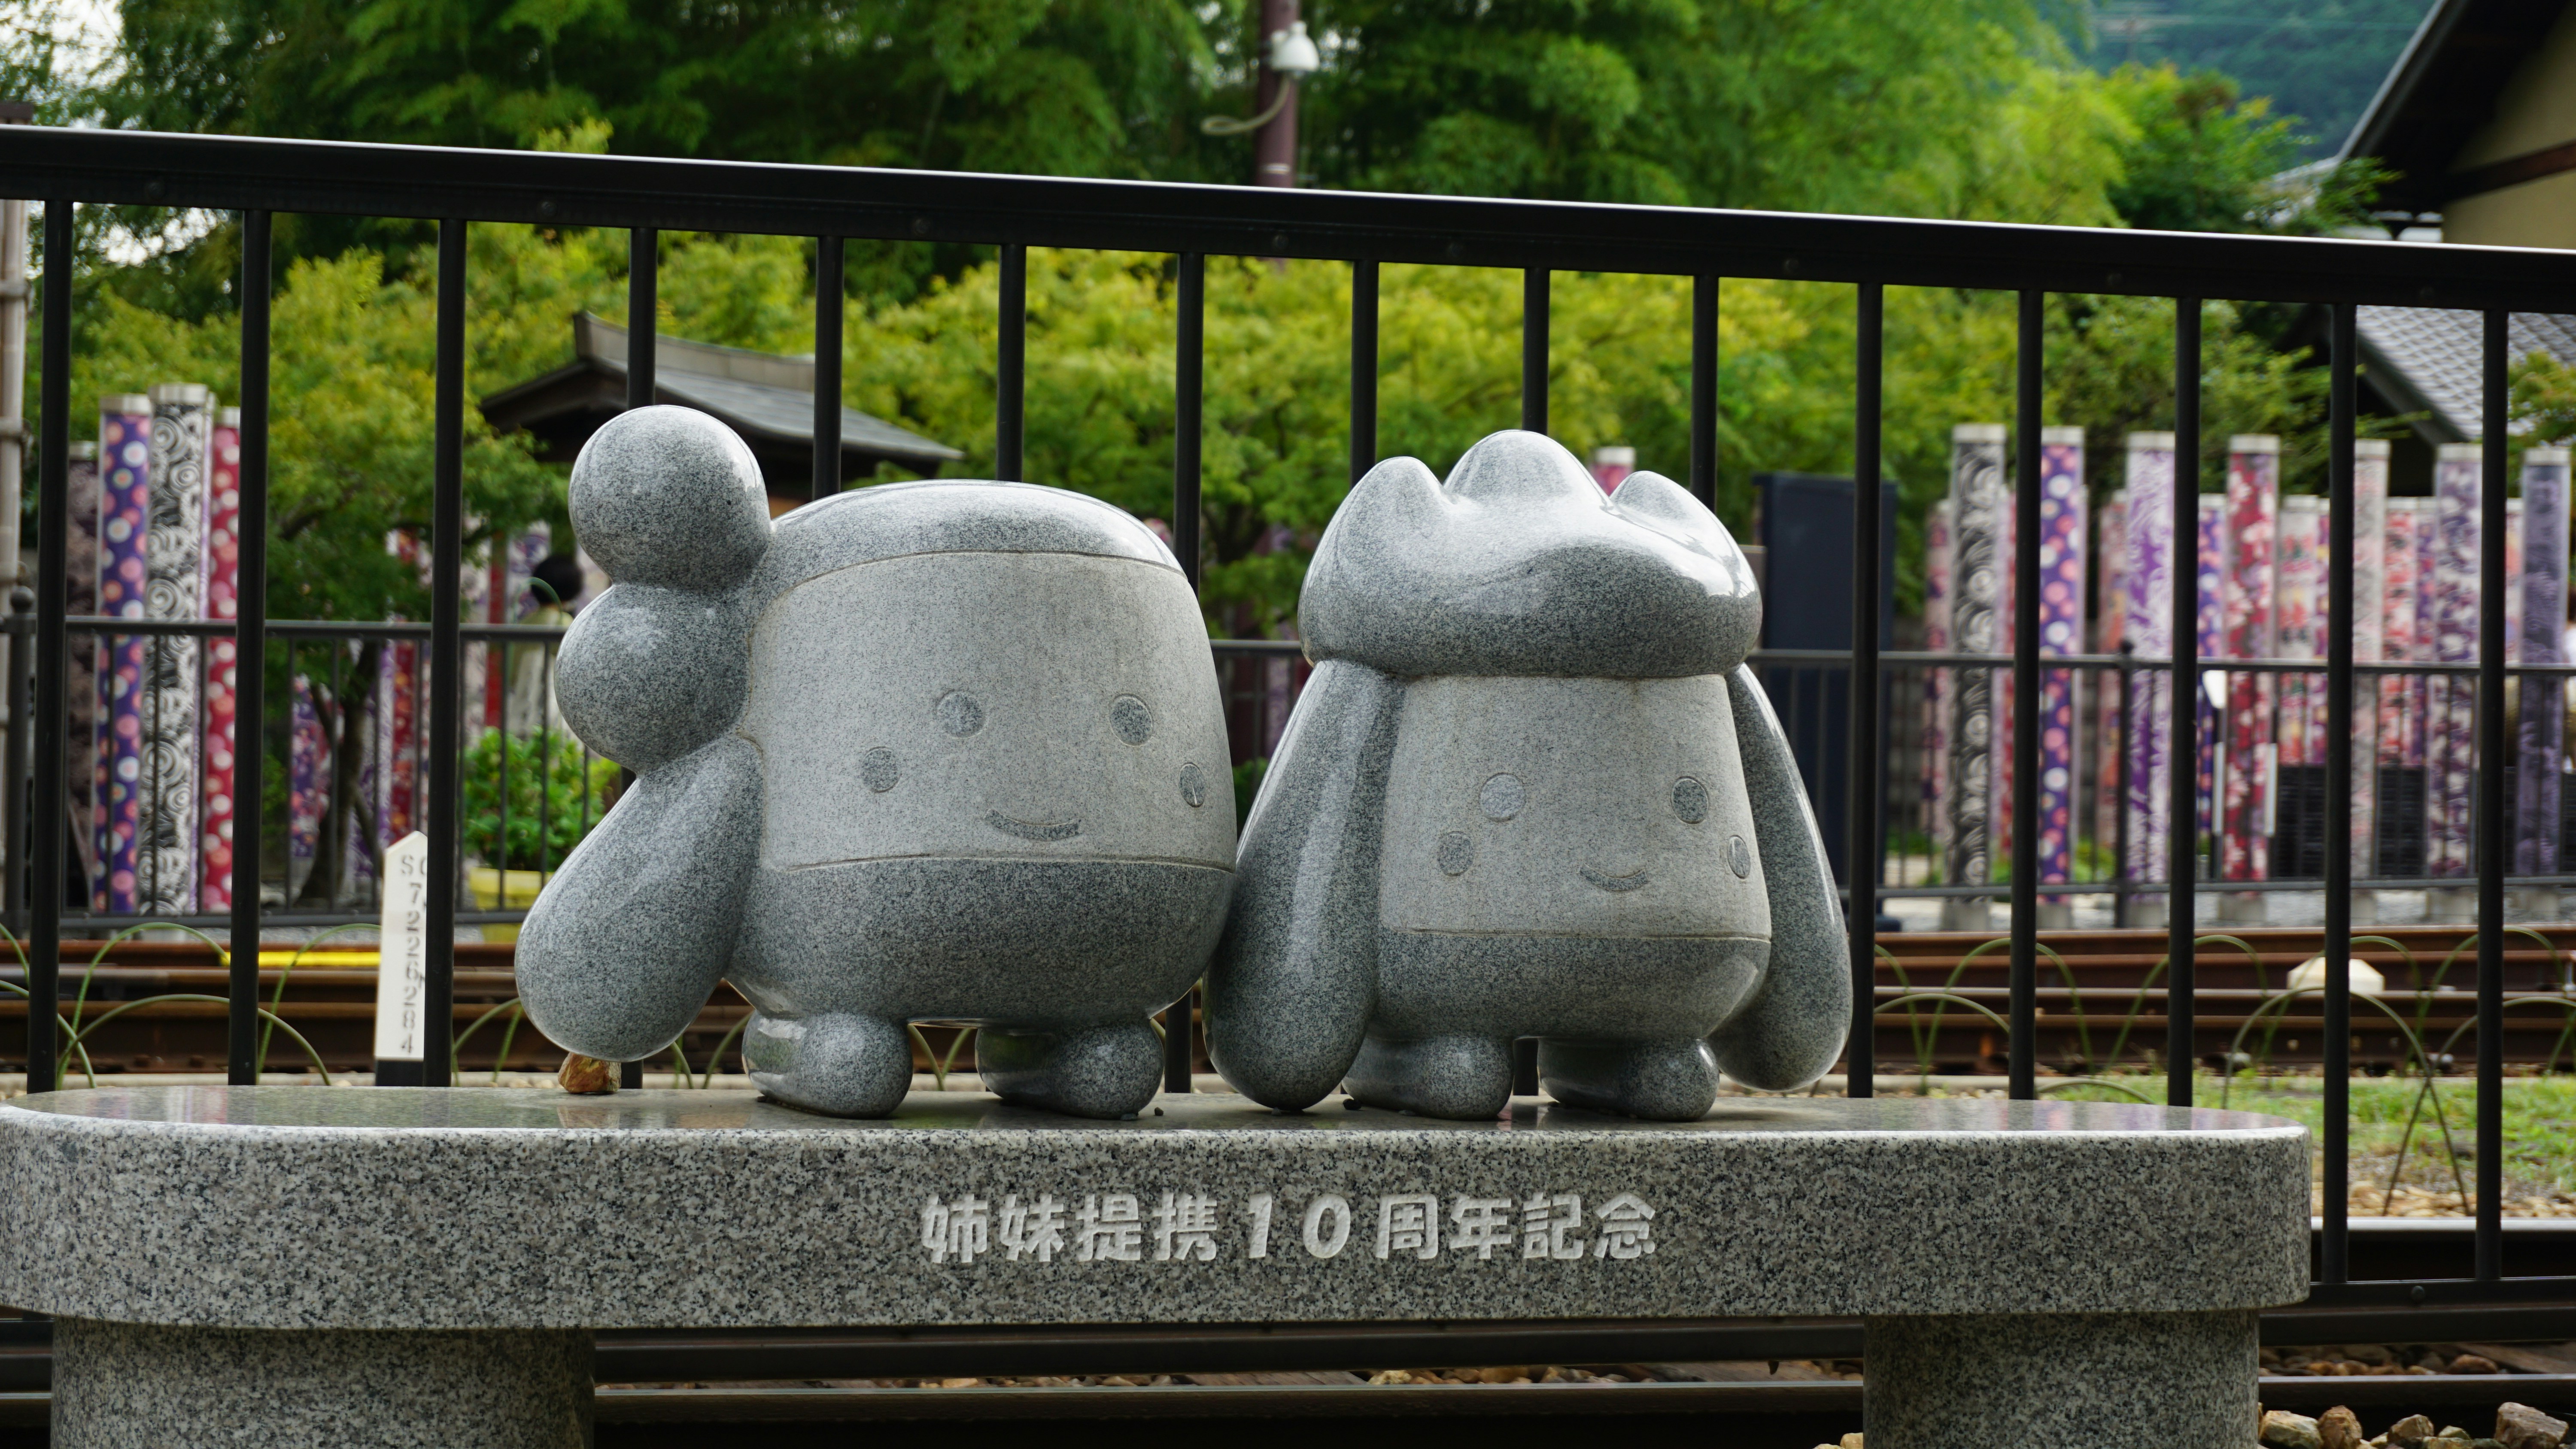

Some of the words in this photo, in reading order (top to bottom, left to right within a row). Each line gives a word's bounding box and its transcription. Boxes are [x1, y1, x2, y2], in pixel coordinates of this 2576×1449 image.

[921, 1192, 1656, 1264] 姉妹提携10周年記念
